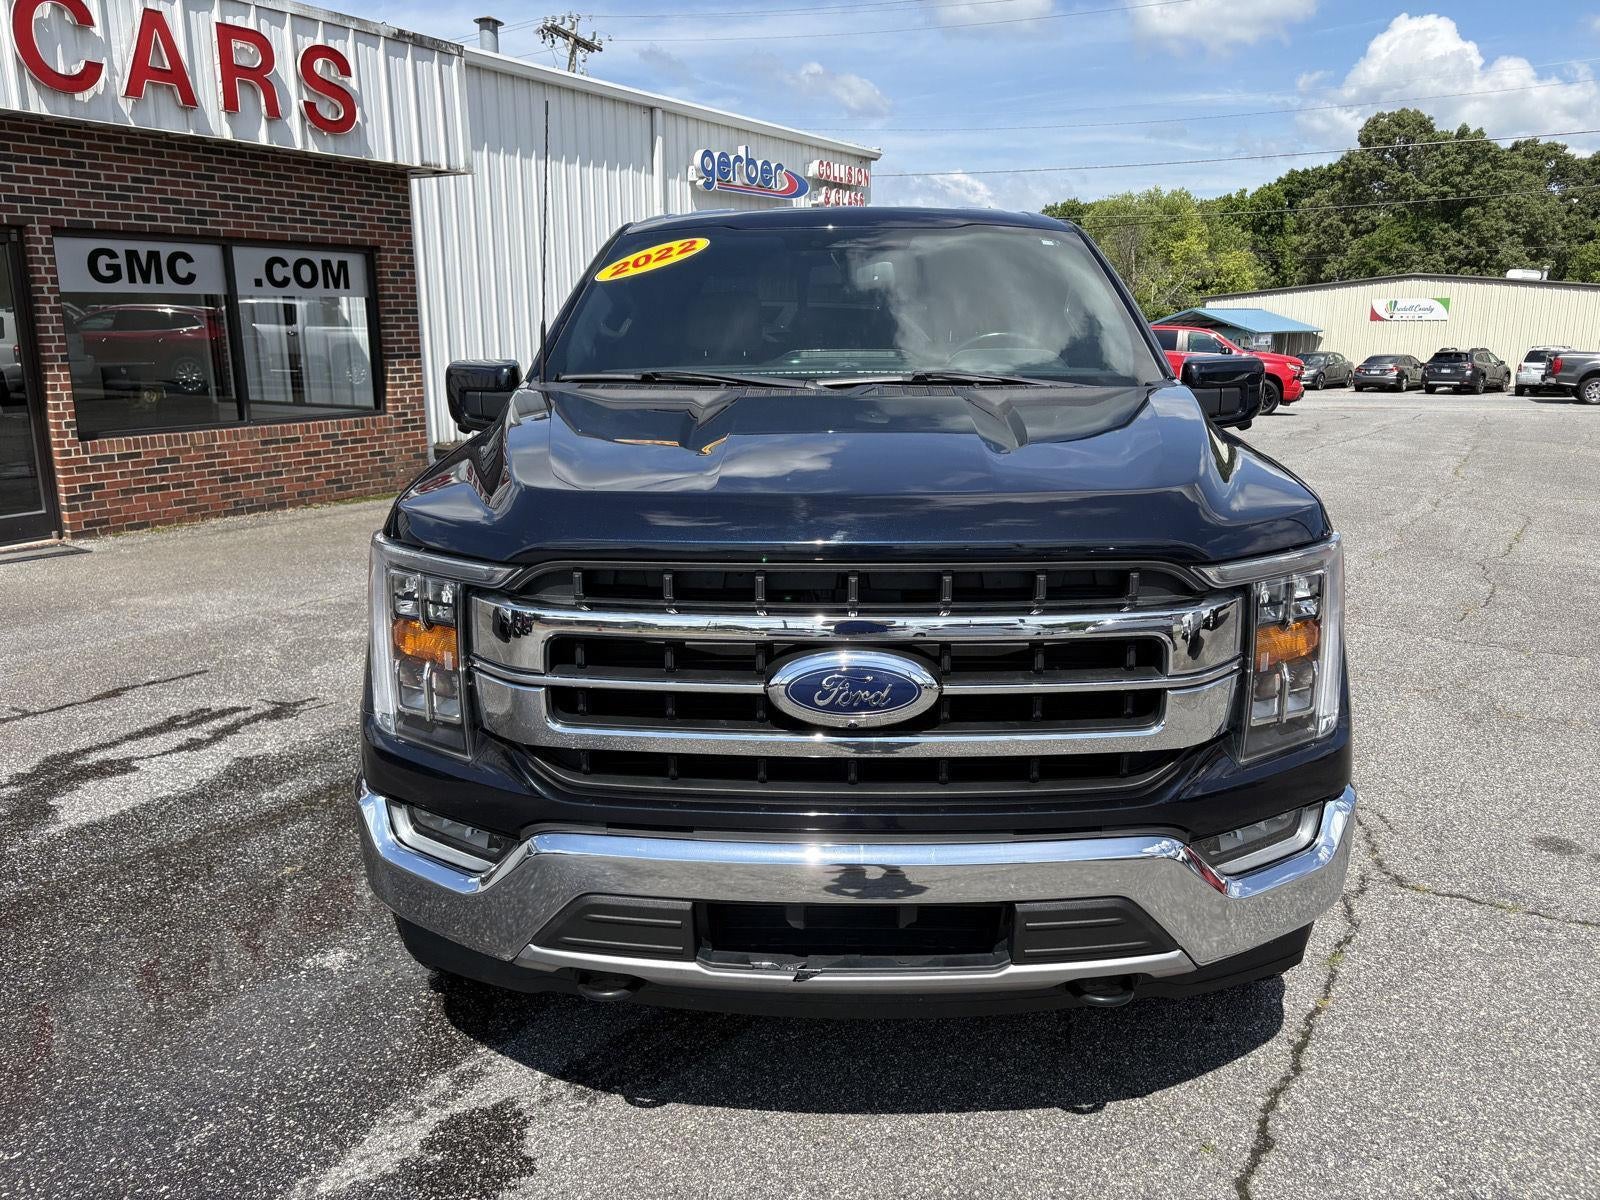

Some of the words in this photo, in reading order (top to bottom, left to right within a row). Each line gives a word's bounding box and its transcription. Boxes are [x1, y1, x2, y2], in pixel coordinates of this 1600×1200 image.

[11, 0, 358, 135] CARS
[699, 145, 785, 191] gerber
[817, 159, 870, 188] COLLISION
[823, 186, 832, 207] &
[834, 188, 865, 207] GLASS
[86, 247, 197, 285] GMC
[253, 256, 351, 290] .COM
[609, 239, 698, 278] 2022
[813, 674, 893, 707] Ford
